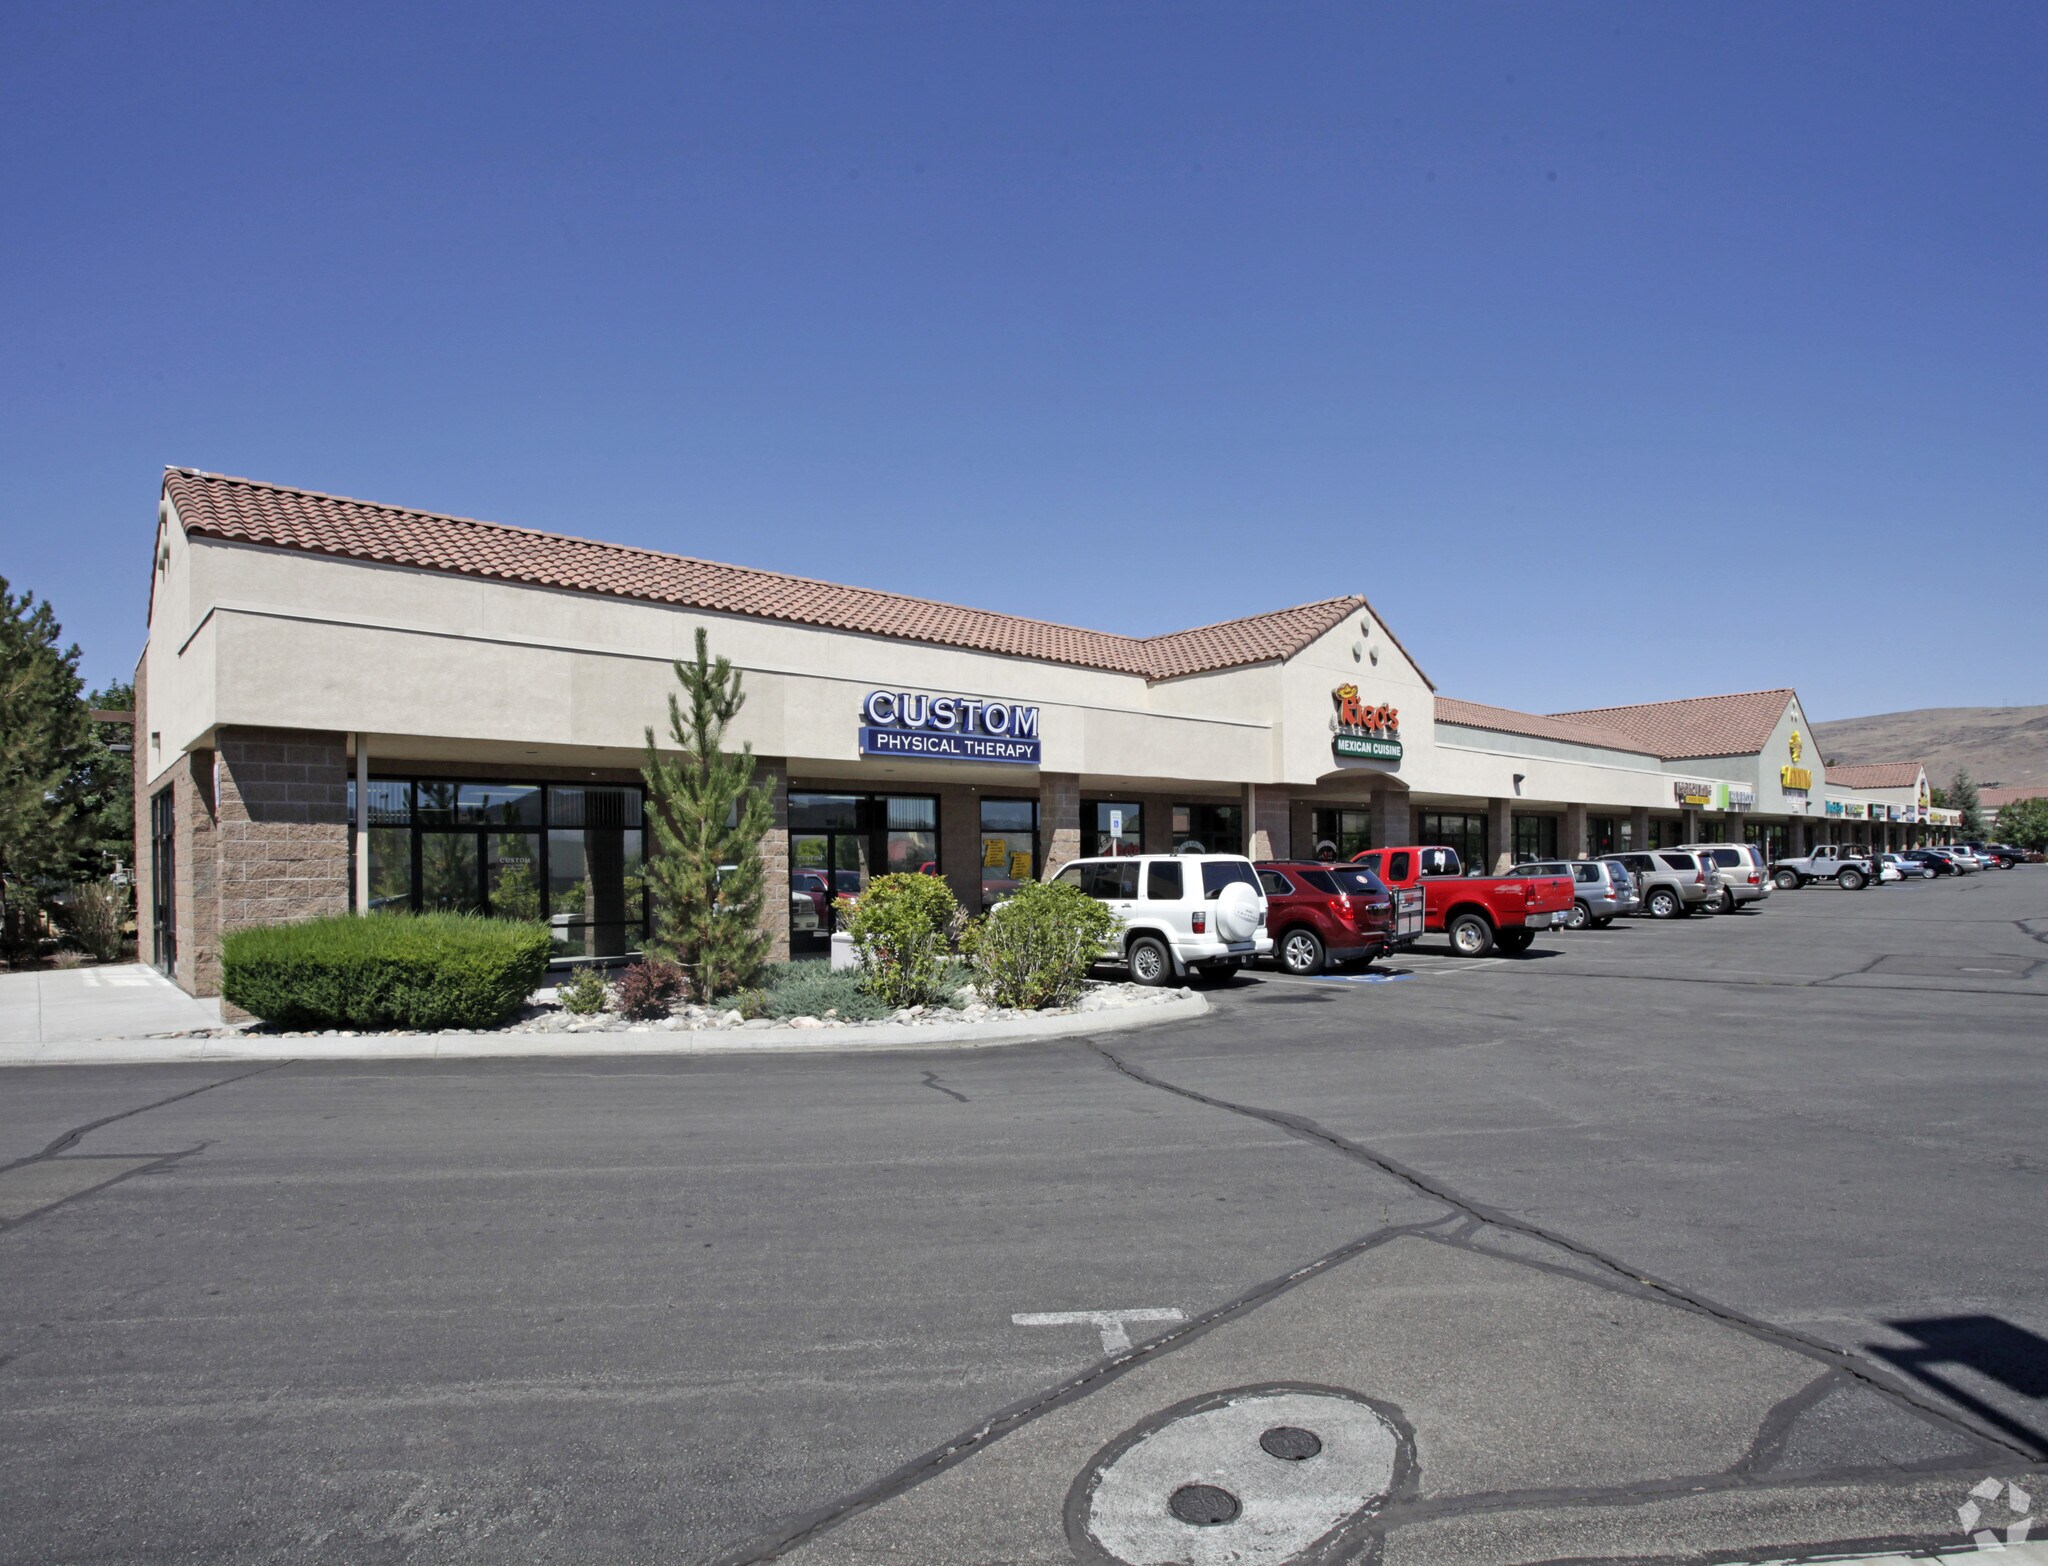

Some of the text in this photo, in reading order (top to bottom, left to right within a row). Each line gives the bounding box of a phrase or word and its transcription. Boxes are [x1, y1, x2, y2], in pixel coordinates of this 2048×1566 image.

[865, 690, 1039, 737] CUSTOM
[877, 733, 1033, 758] PHYSICAL THERAPY
[1338, 739, 1401, 756] MEXICAN CUISINE
